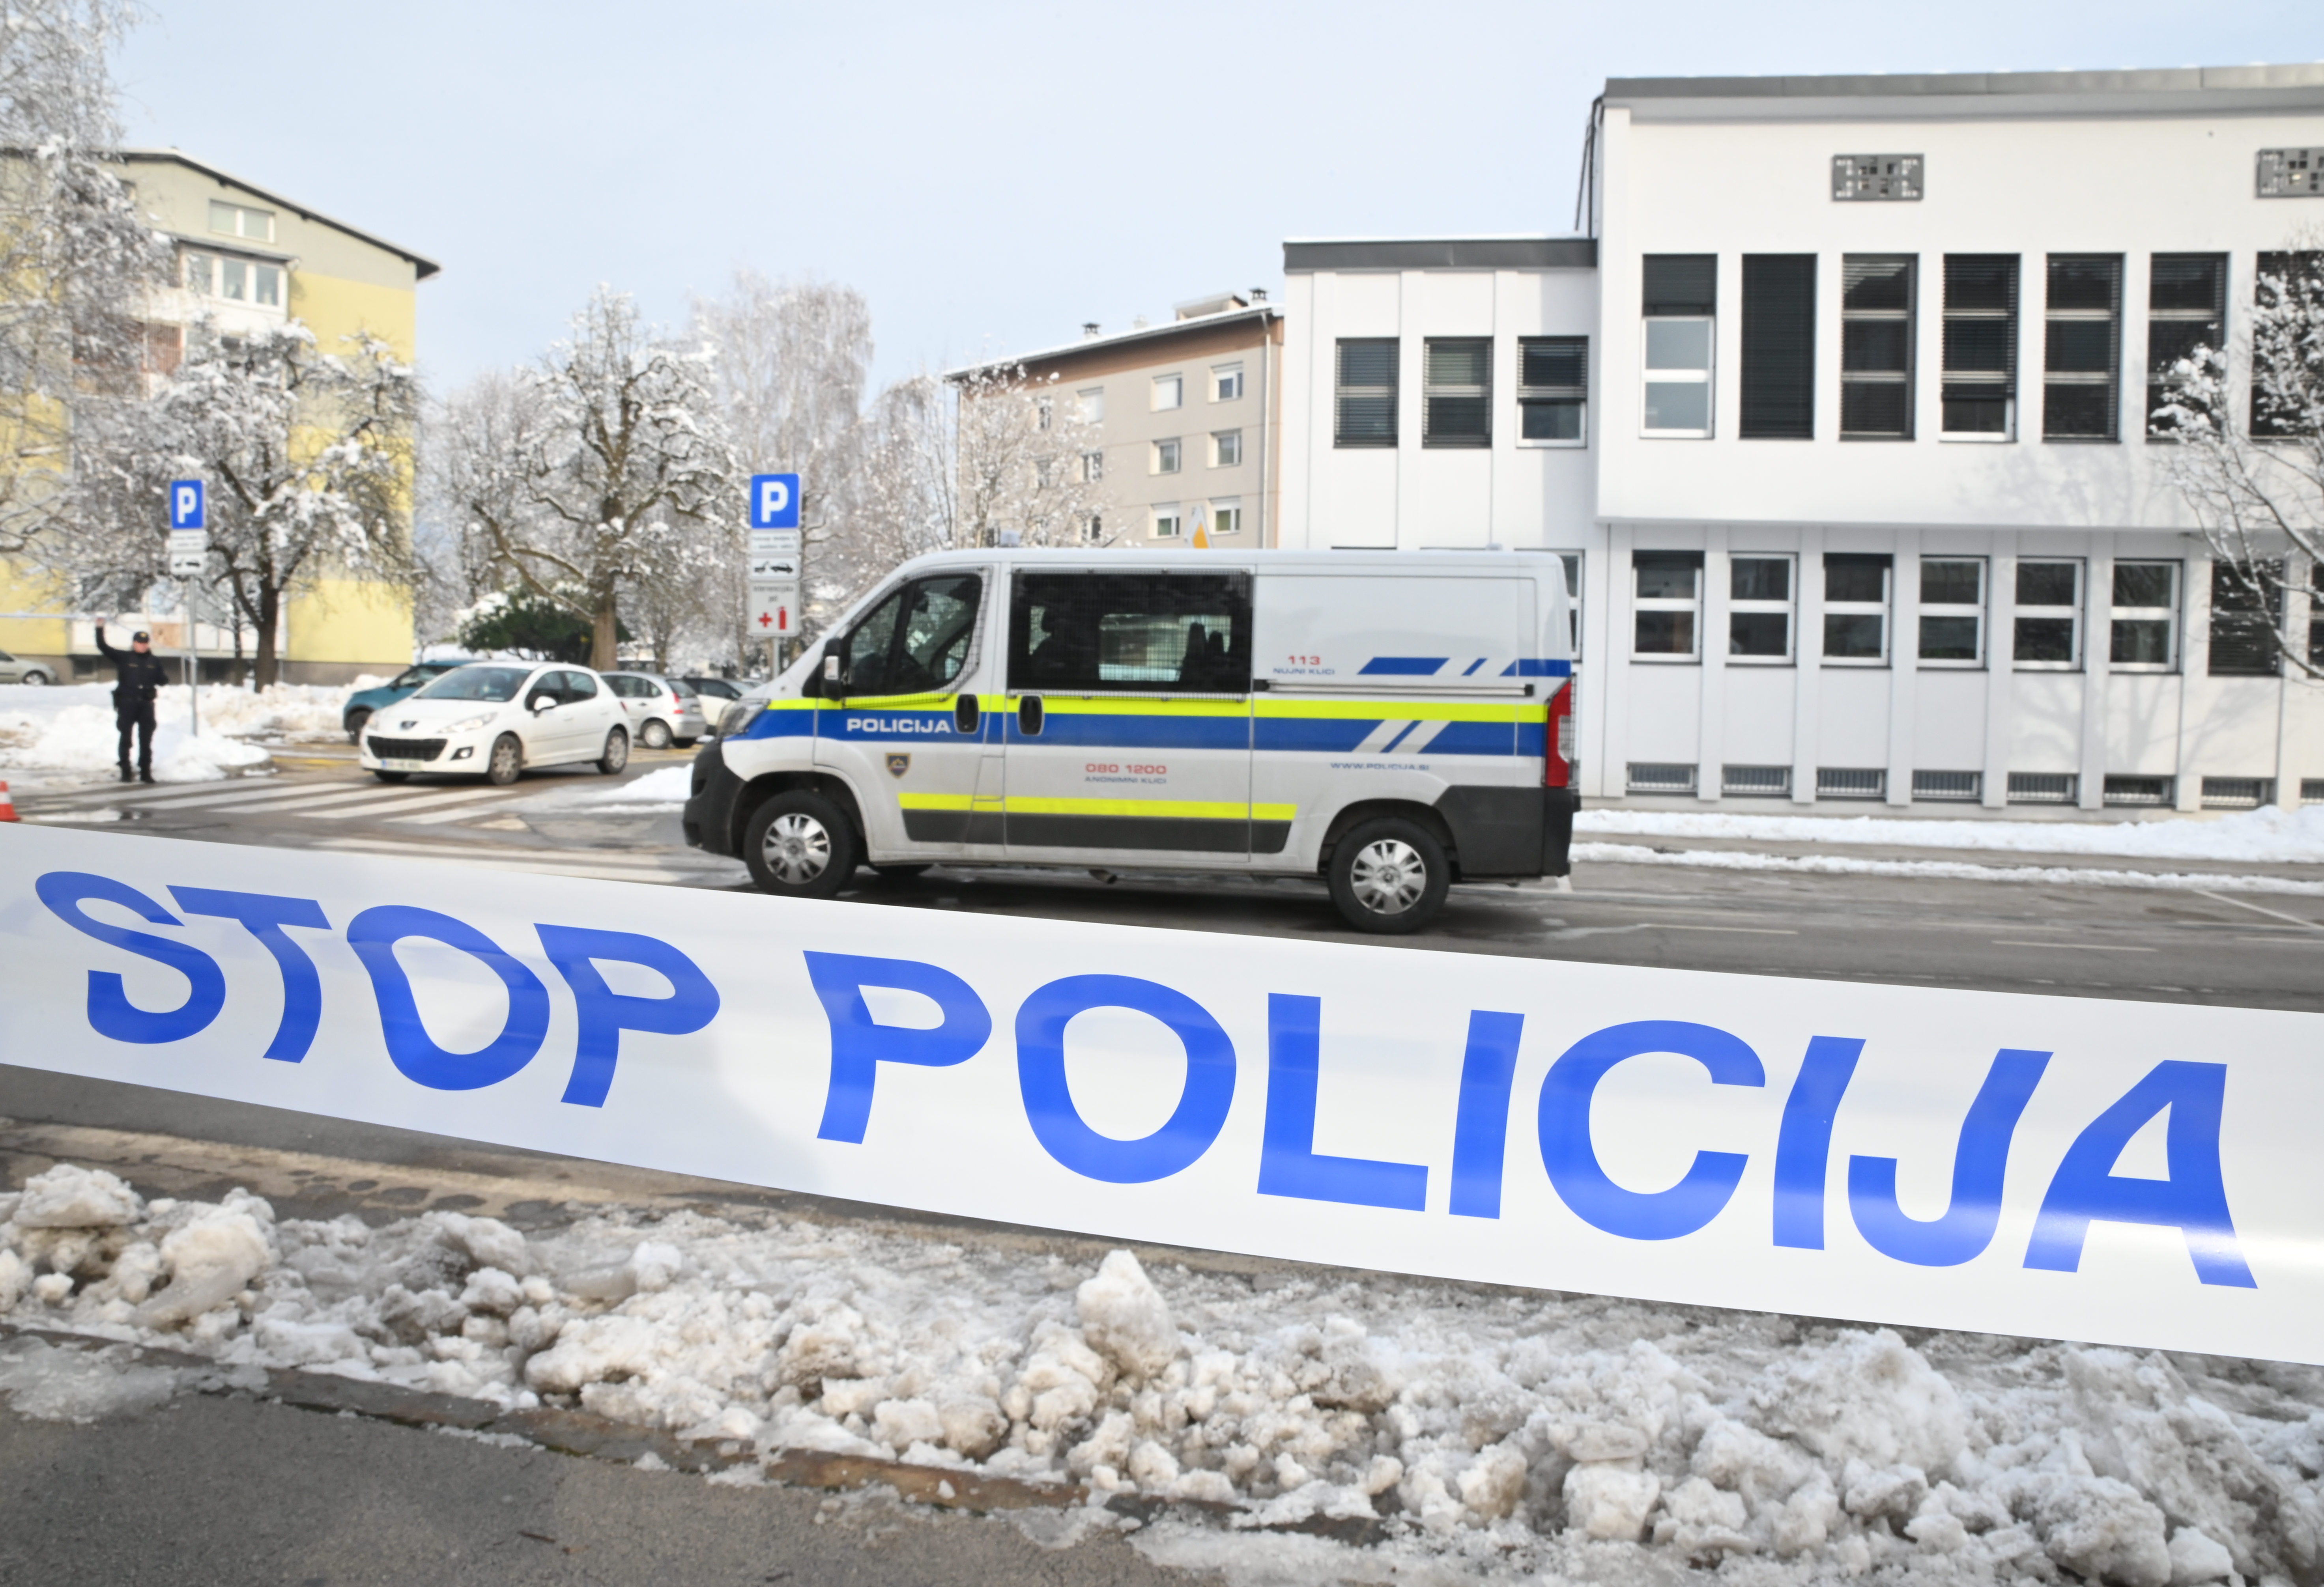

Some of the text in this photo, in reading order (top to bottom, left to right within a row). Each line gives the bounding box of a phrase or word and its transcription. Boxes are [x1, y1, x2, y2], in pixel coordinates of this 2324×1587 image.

[178, 487, 196, 523] P
[761, 482, 788, 522] P
[1288, 655, 1320, 665] 113
[847, 718, 951, 733] POLICIJA
[1086, 764, 1167, 774] 080 1200
[36, 871, 2257, 1289] STOP POLICIJA
